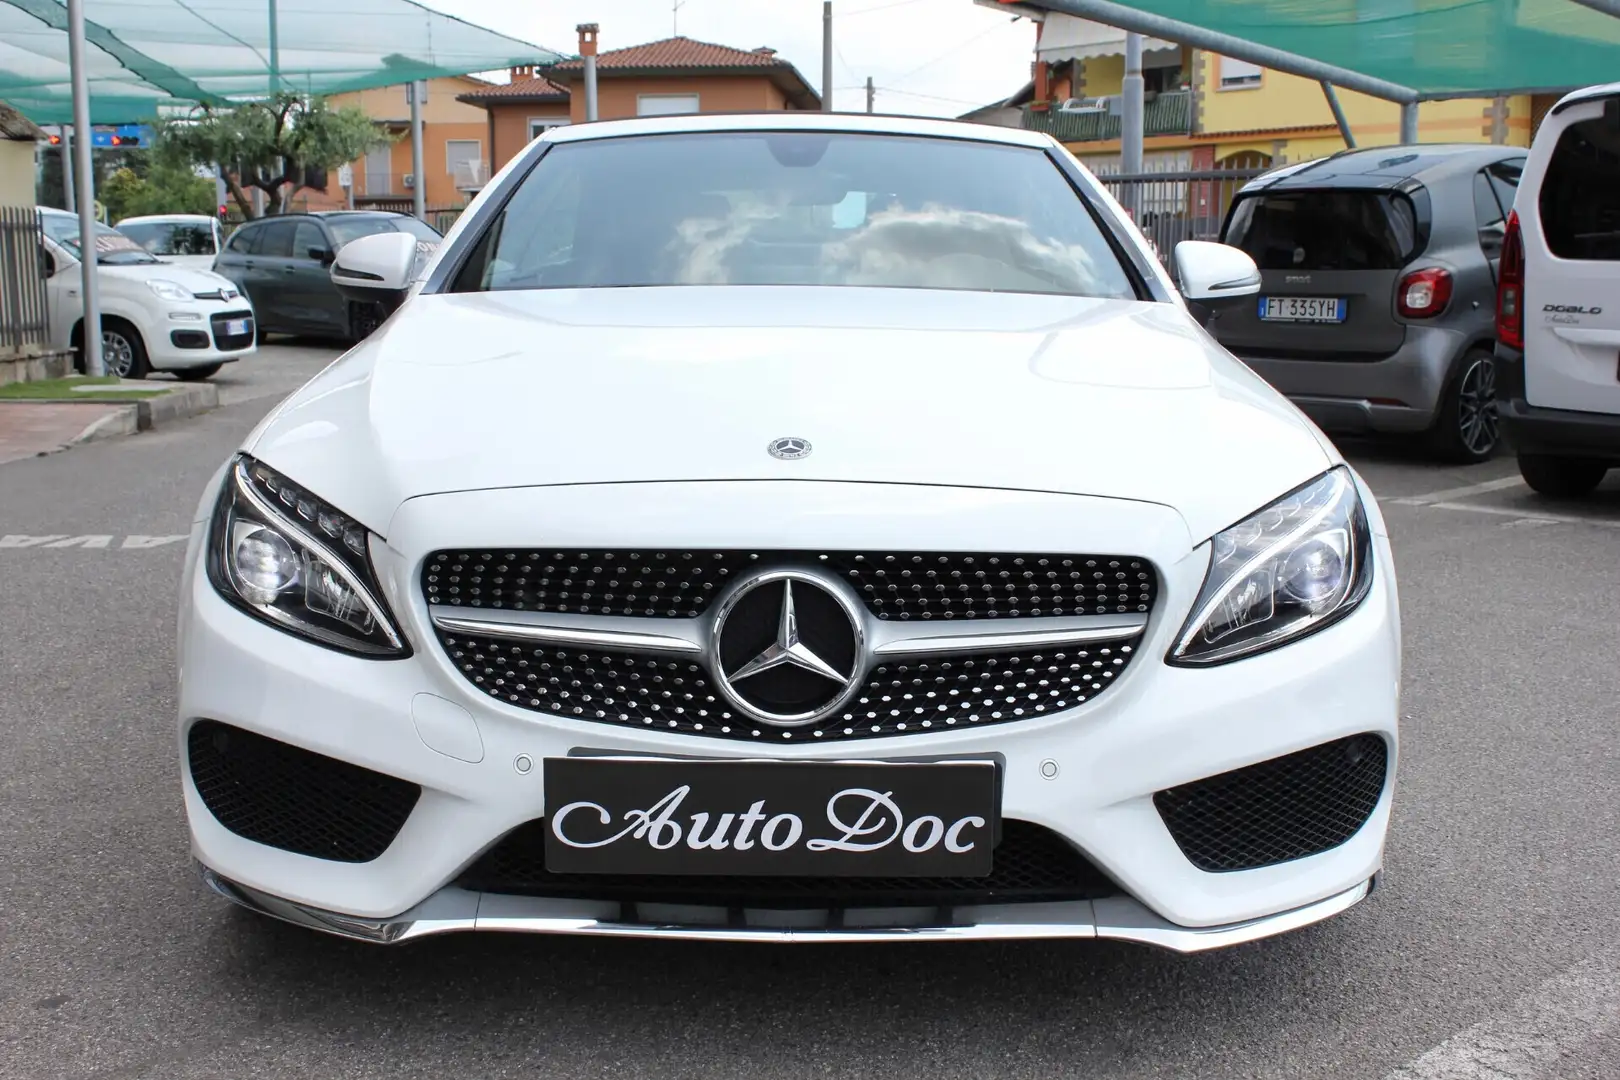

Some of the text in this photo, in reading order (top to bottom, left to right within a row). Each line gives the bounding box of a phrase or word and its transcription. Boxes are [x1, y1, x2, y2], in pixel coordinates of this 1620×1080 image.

[1268, 299, 1285, 315] FT
[1290, 299, 1335, 317] 335YH
[1543, 304, 1602, 314] DOBLO
